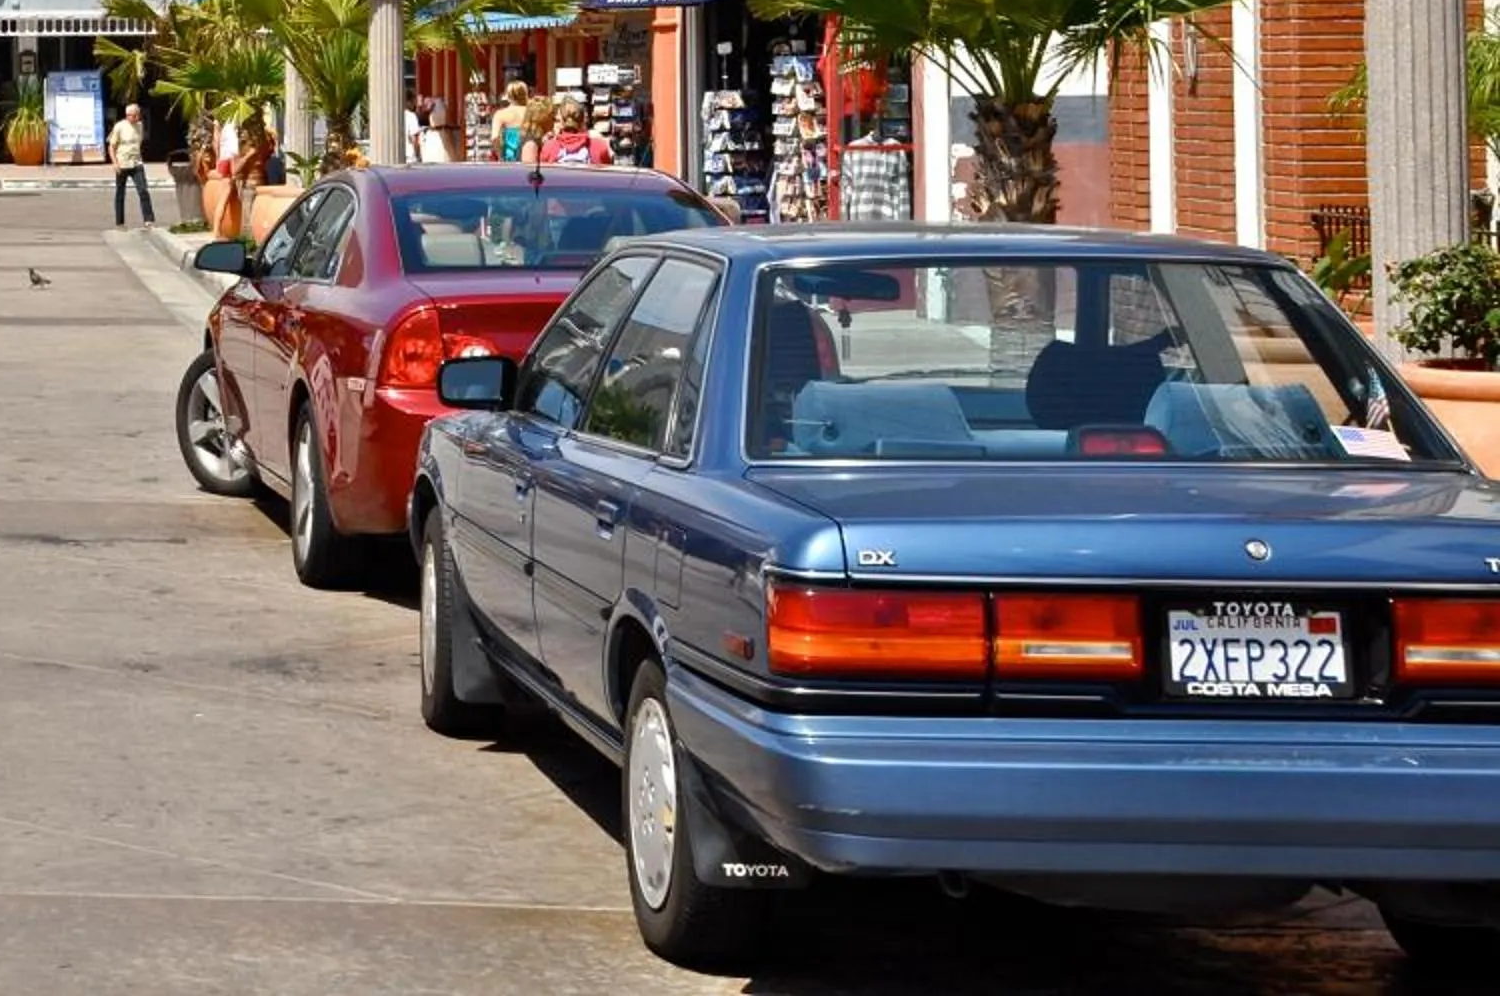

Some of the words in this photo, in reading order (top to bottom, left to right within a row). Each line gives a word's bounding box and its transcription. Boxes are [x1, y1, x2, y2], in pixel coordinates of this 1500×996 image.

[858, 550, 896, 565] DX
[1213, 602, 1295, 617] TOYOTA
[1173, 619, 1199, 631] JUL
[1206, 615, 1301, 629] CALIFORNIA
[1178, 638, 1338, 682] 2XFP322
[1187, 682, 1260, 696] COSTA
[1267, 682, 1333, 697] MESA
[722, 863, 789, 877] TOYOTA
